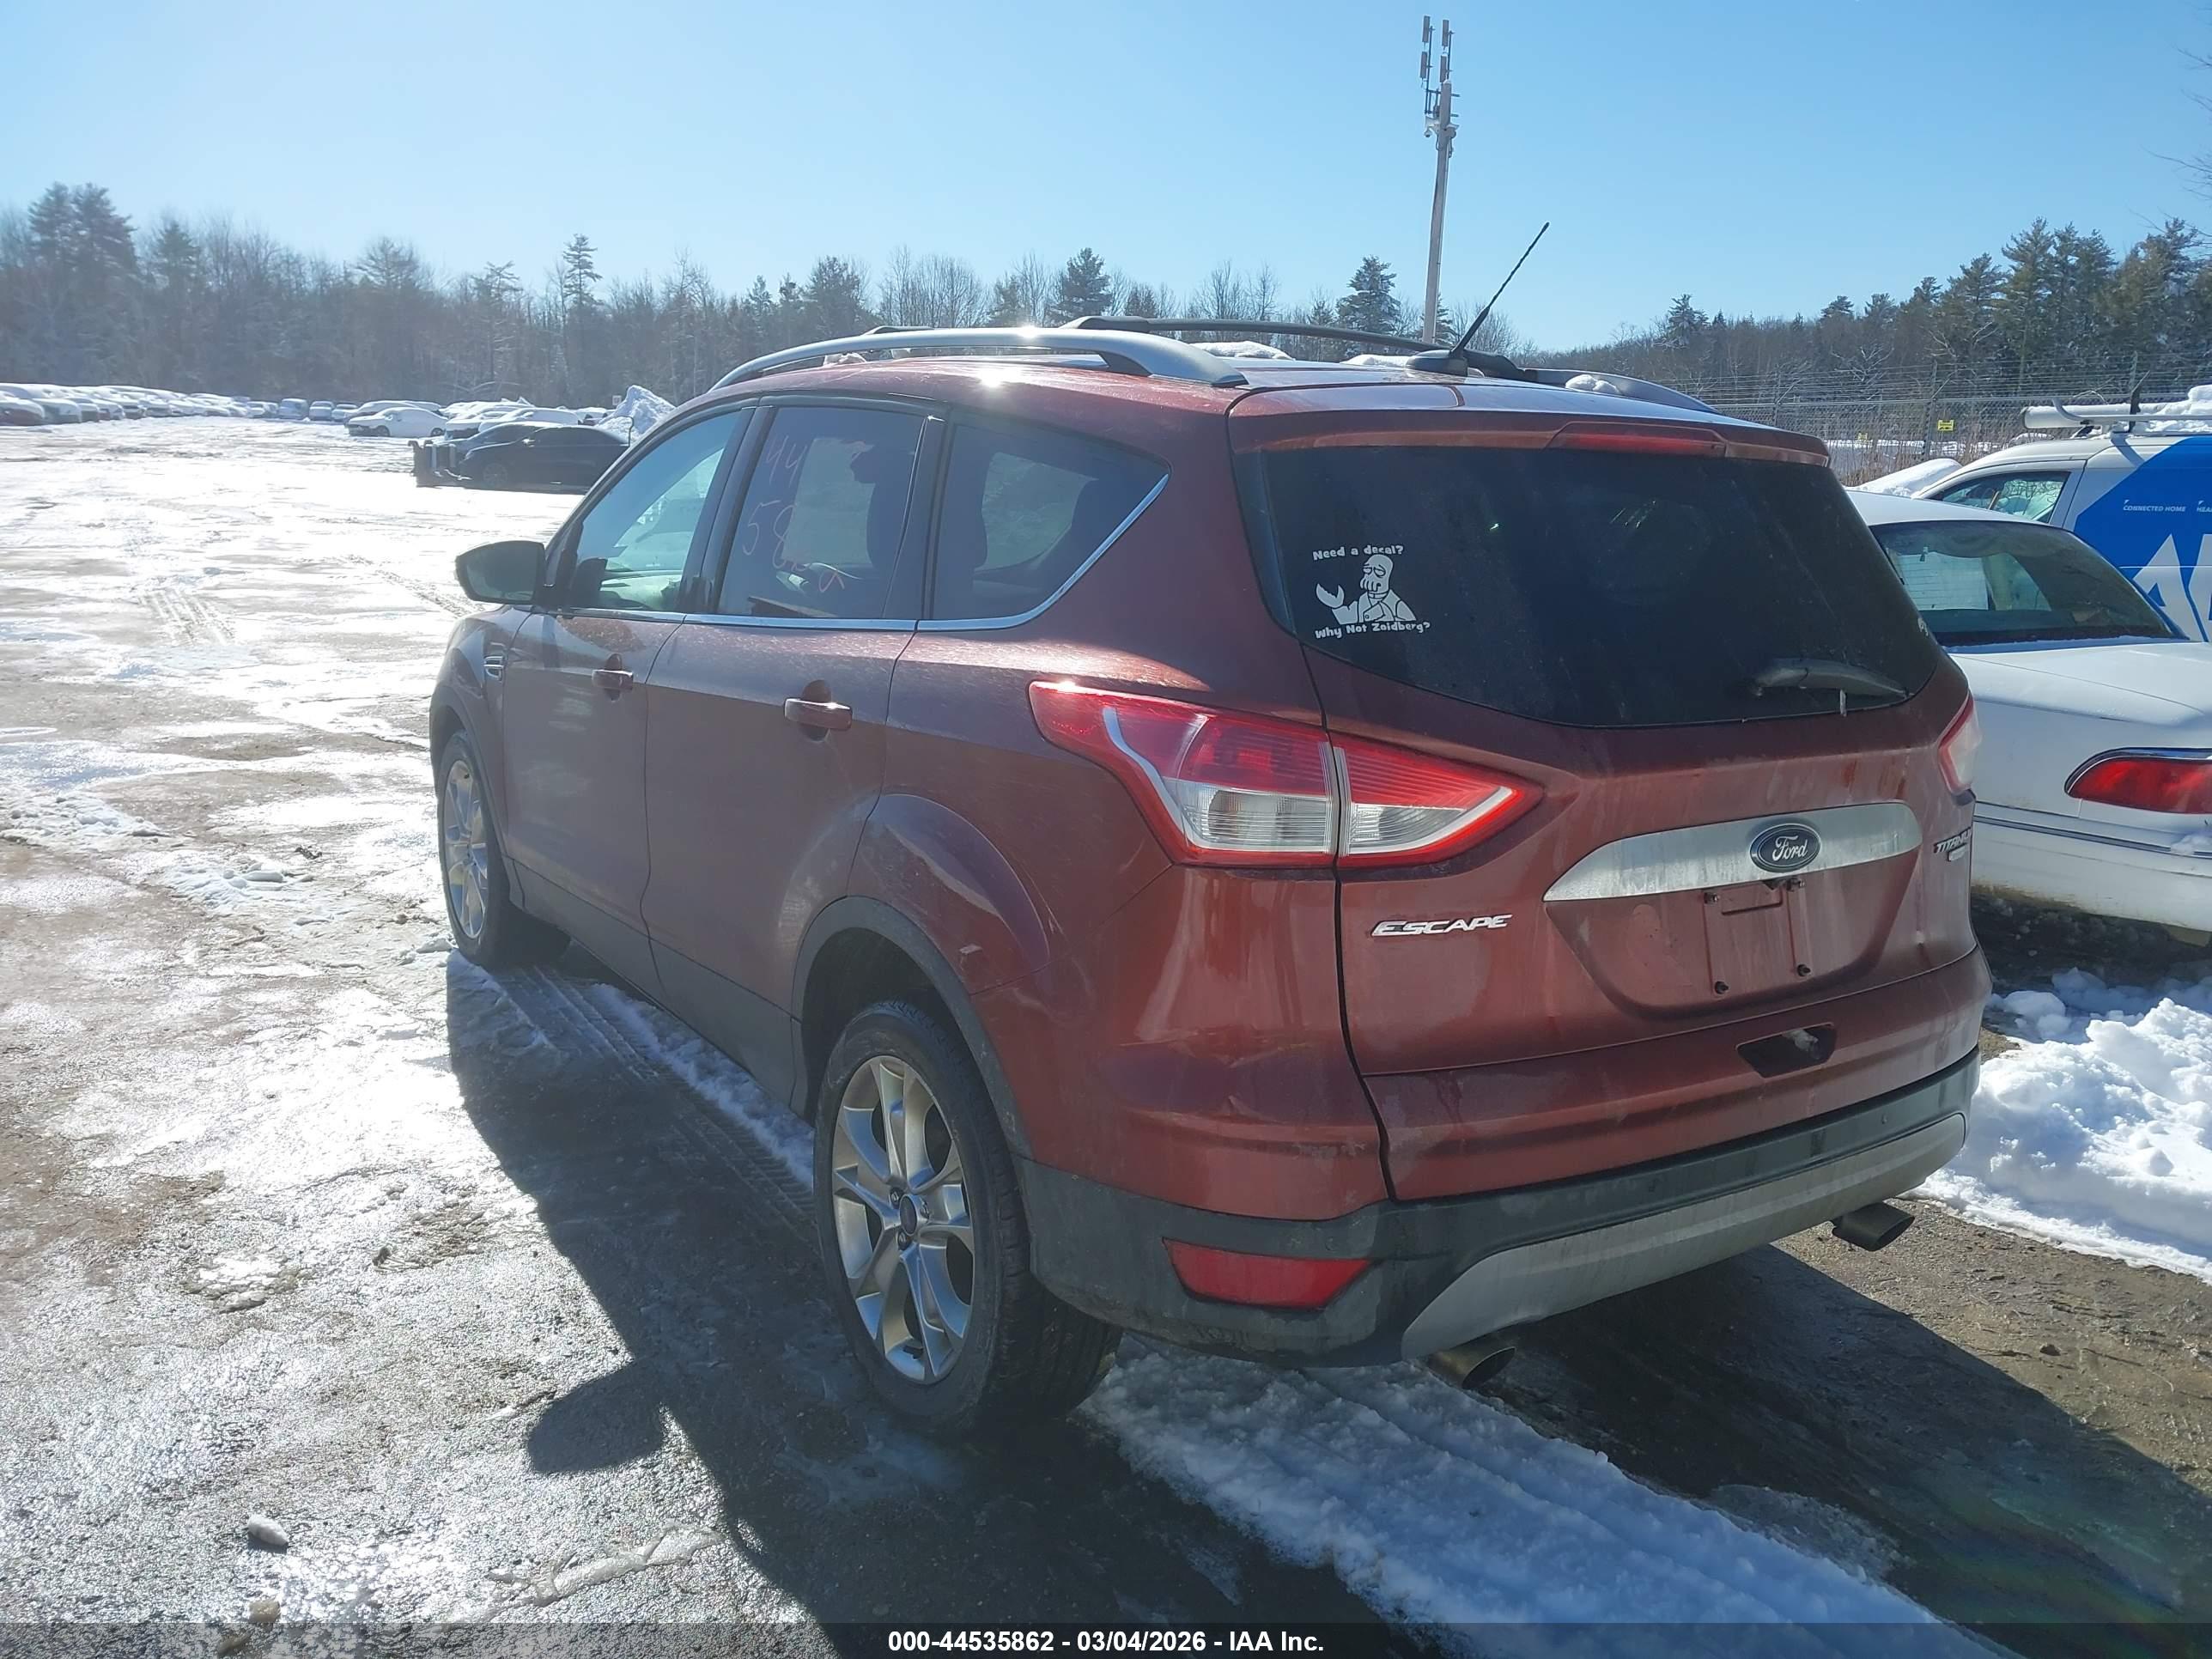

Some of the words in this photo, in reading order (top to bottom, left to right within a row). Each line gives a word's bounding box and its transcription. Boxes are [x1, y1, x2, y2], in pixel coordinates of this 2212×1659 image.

[1313, 547, 1345, 561] Need
[1364, 545, 1404, 556] decal?
[1315, 628, 1342, 639] Why
[1346, 623, 1367, 634] Not
[1372, 622, 1431, 634] Zoidberg?
[1772, 835, 1808, 861] Ford
[1371, 915, 1513, 936] ESCAPE
